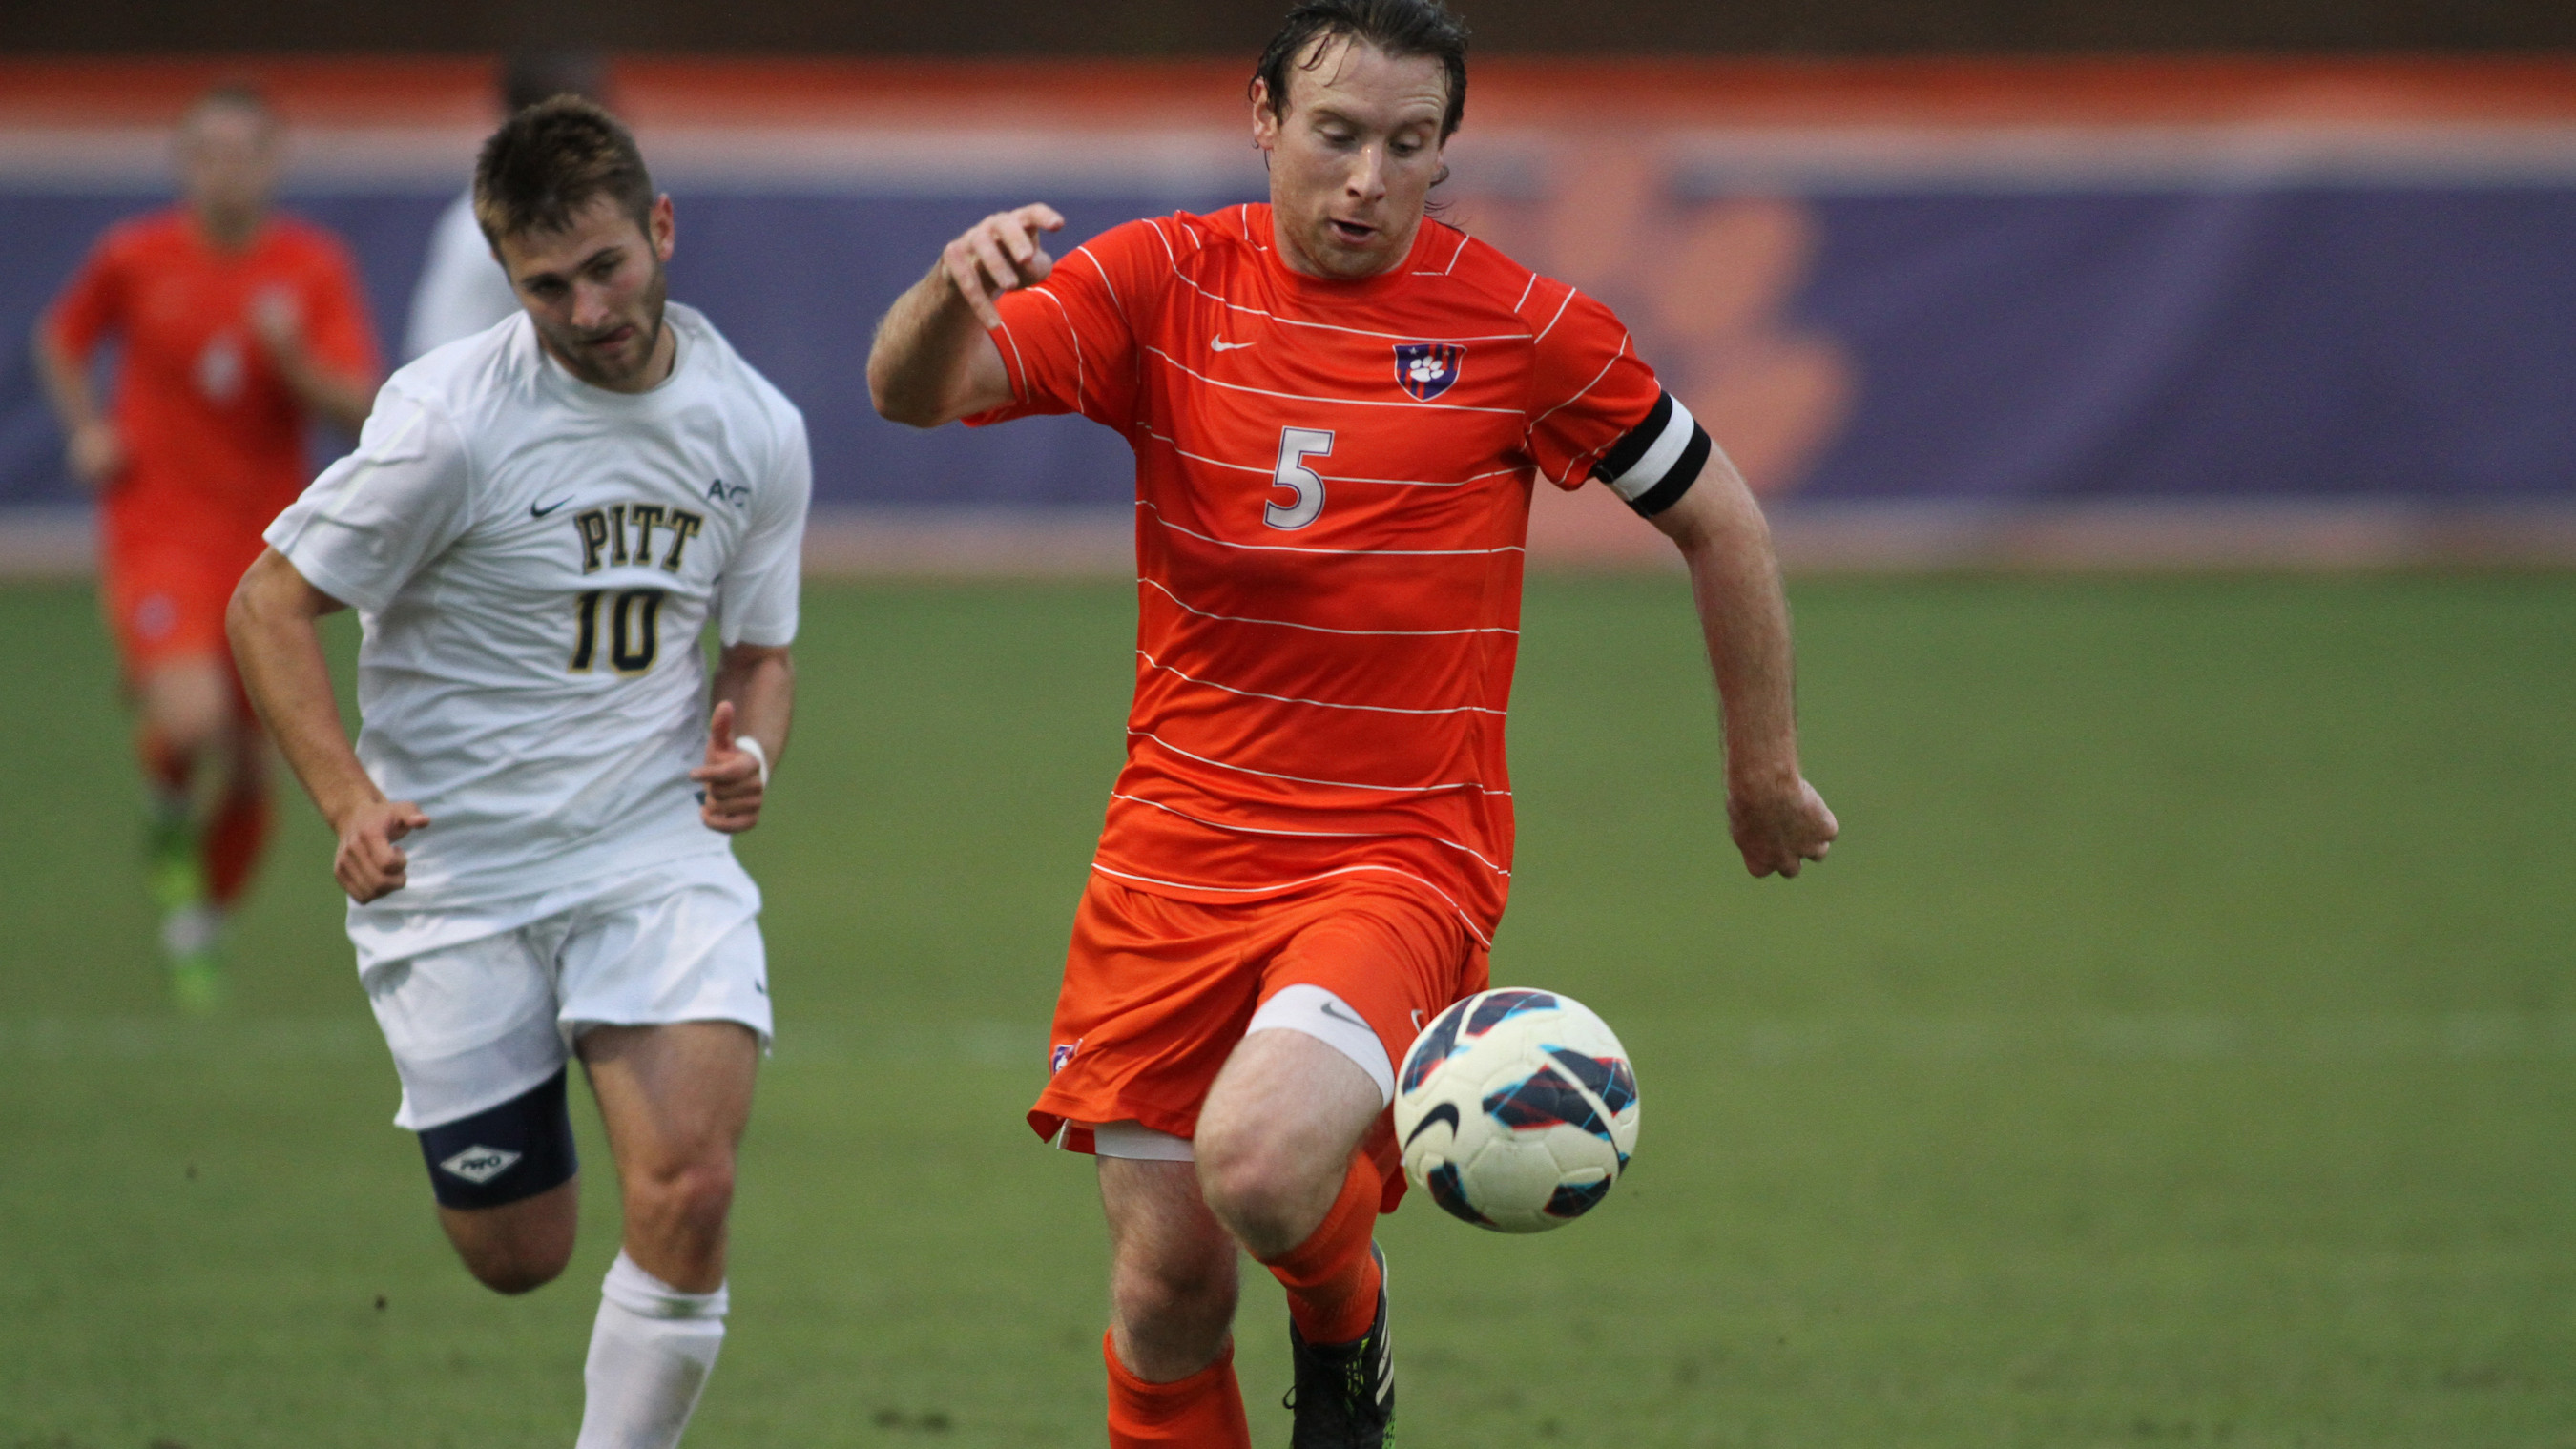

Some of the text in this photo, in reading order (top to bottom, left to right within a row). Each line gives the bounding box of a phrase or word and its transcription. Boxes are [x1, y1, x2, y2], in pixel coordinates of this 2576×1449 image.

[1262, 425, 1335, 531] 5
[574, 503, 704, 574] PITT
[567, 589, 667, 676] 10
